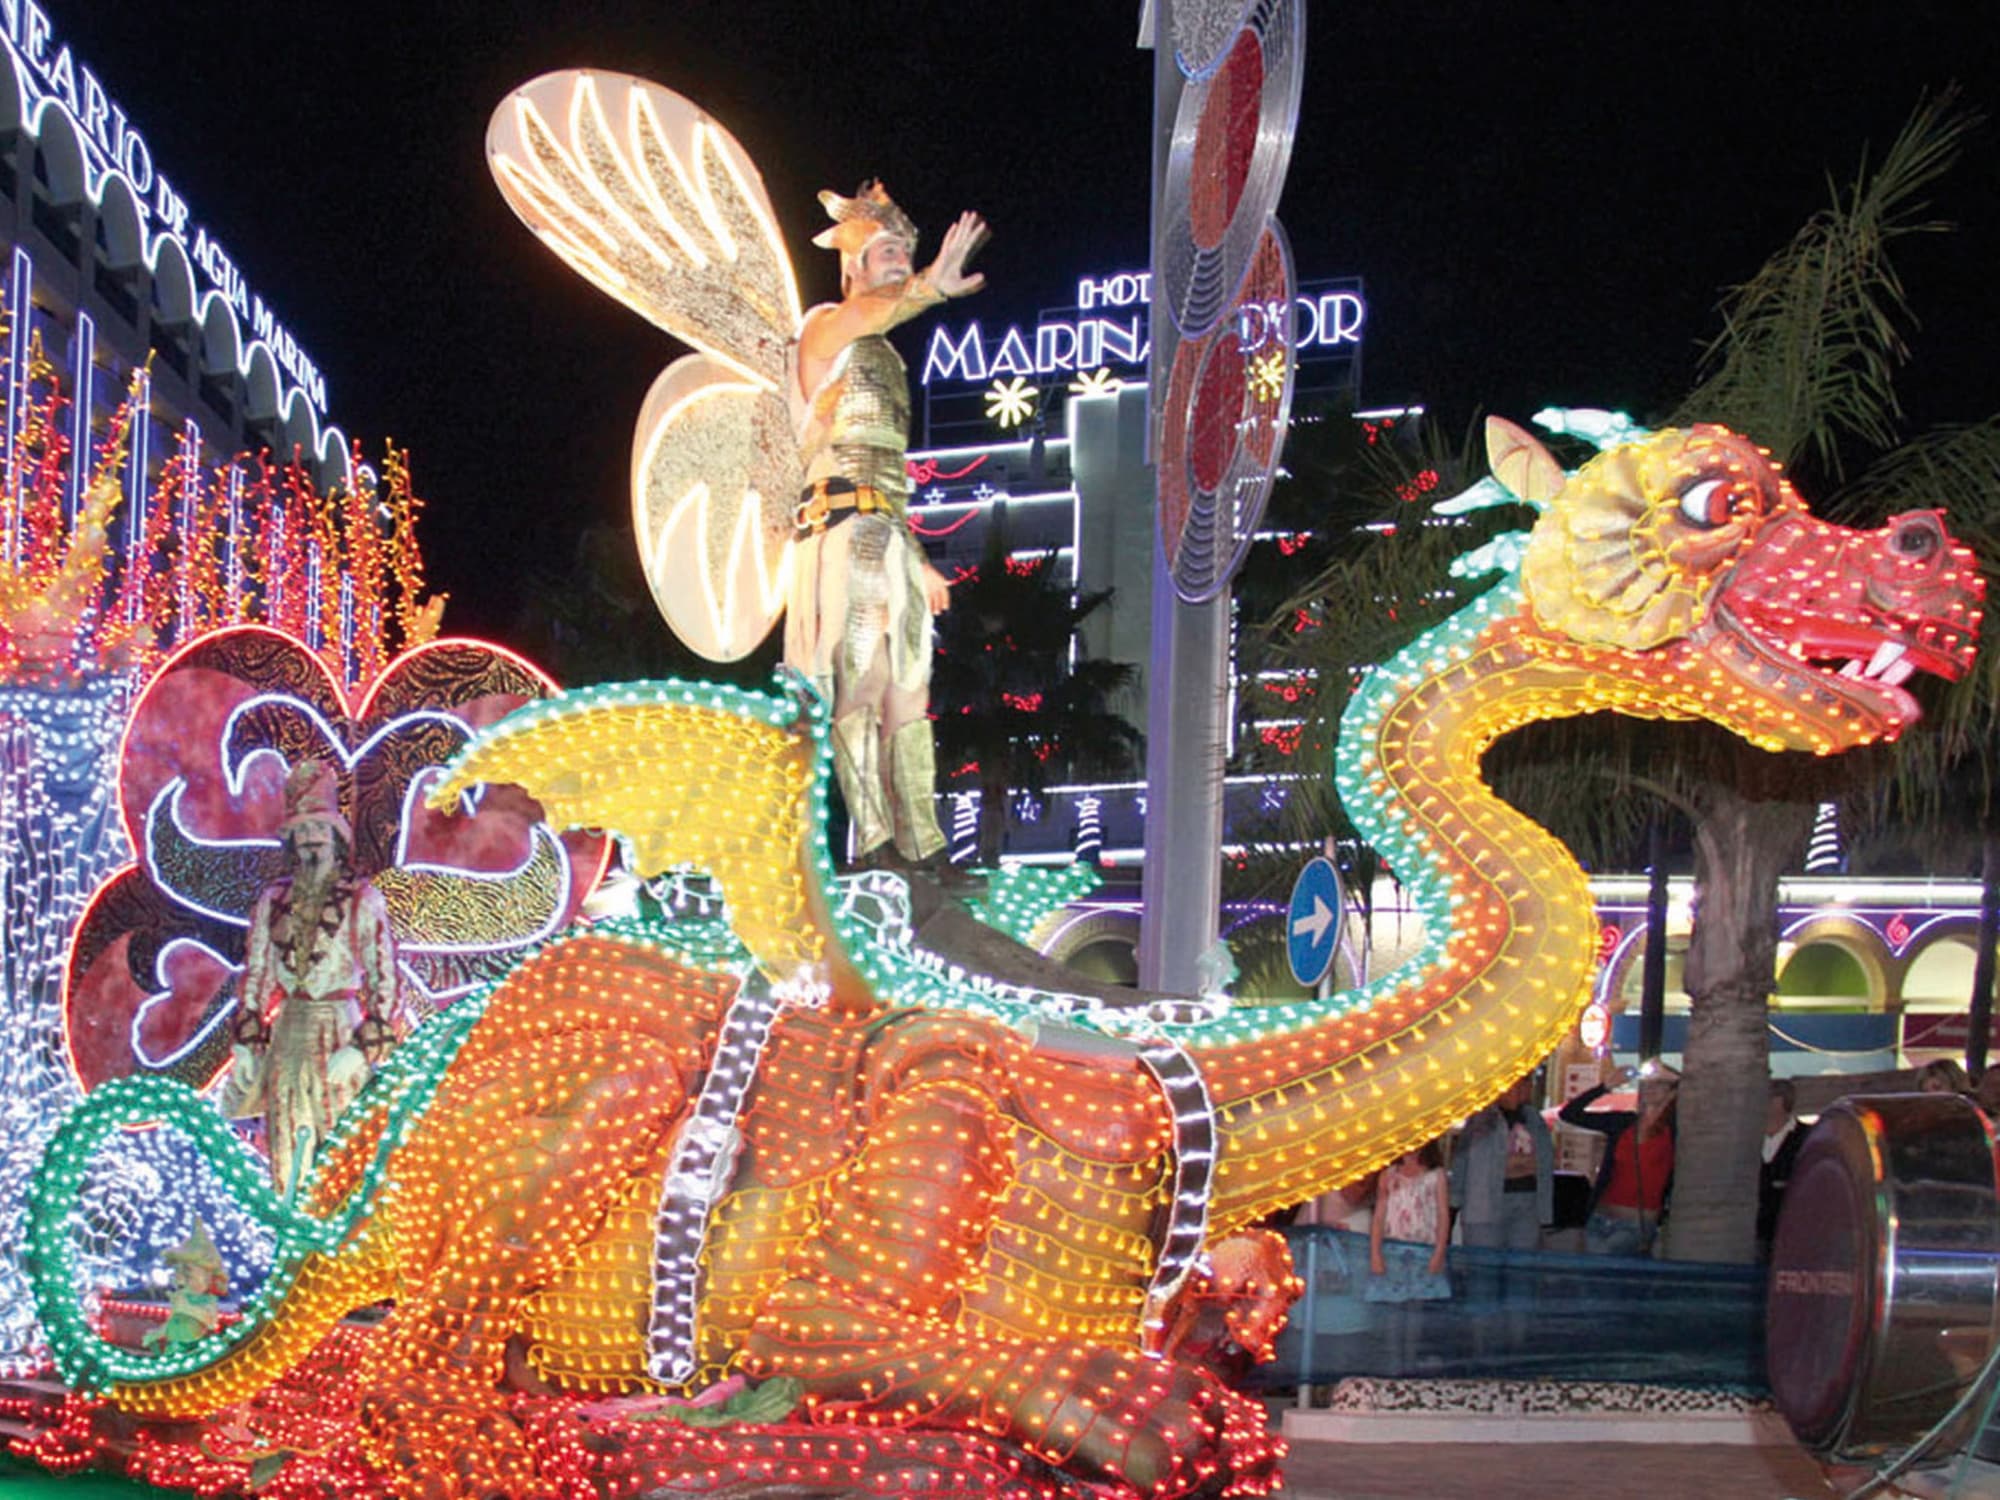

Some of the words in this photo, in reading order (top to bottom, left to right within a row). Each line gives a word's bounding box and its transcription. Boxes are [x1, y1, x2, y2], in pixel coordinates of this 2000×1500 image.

[156, 175, 188, 246] DE
[194, 228, 249, 321] AGUA
[253, 296, 328, 415] MARINA
[921, 316, 1150, 385] MARIN
